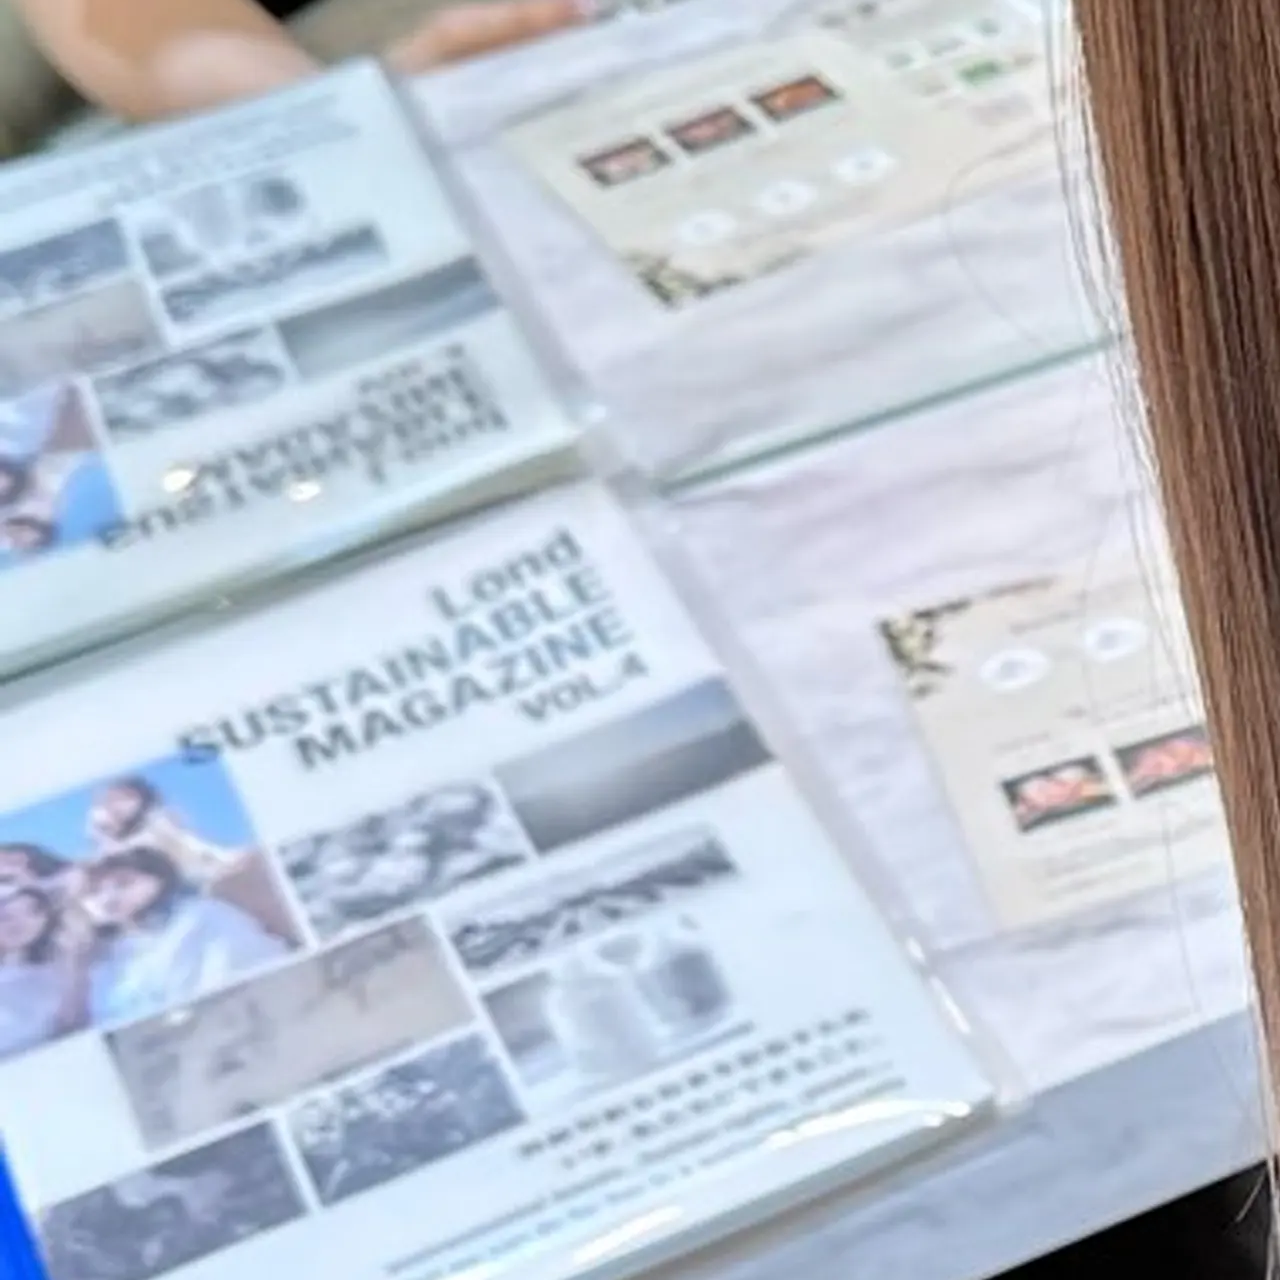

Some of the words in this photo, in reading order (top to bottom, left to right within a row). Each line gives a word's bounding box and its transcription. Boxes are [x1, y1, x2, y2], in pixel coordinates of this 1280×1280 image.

[430, 527, 580, 619] Lond
[178, 565, 611, 765] SUSTAINABLE
[294, 608, 633, 768] MAGAZINE
